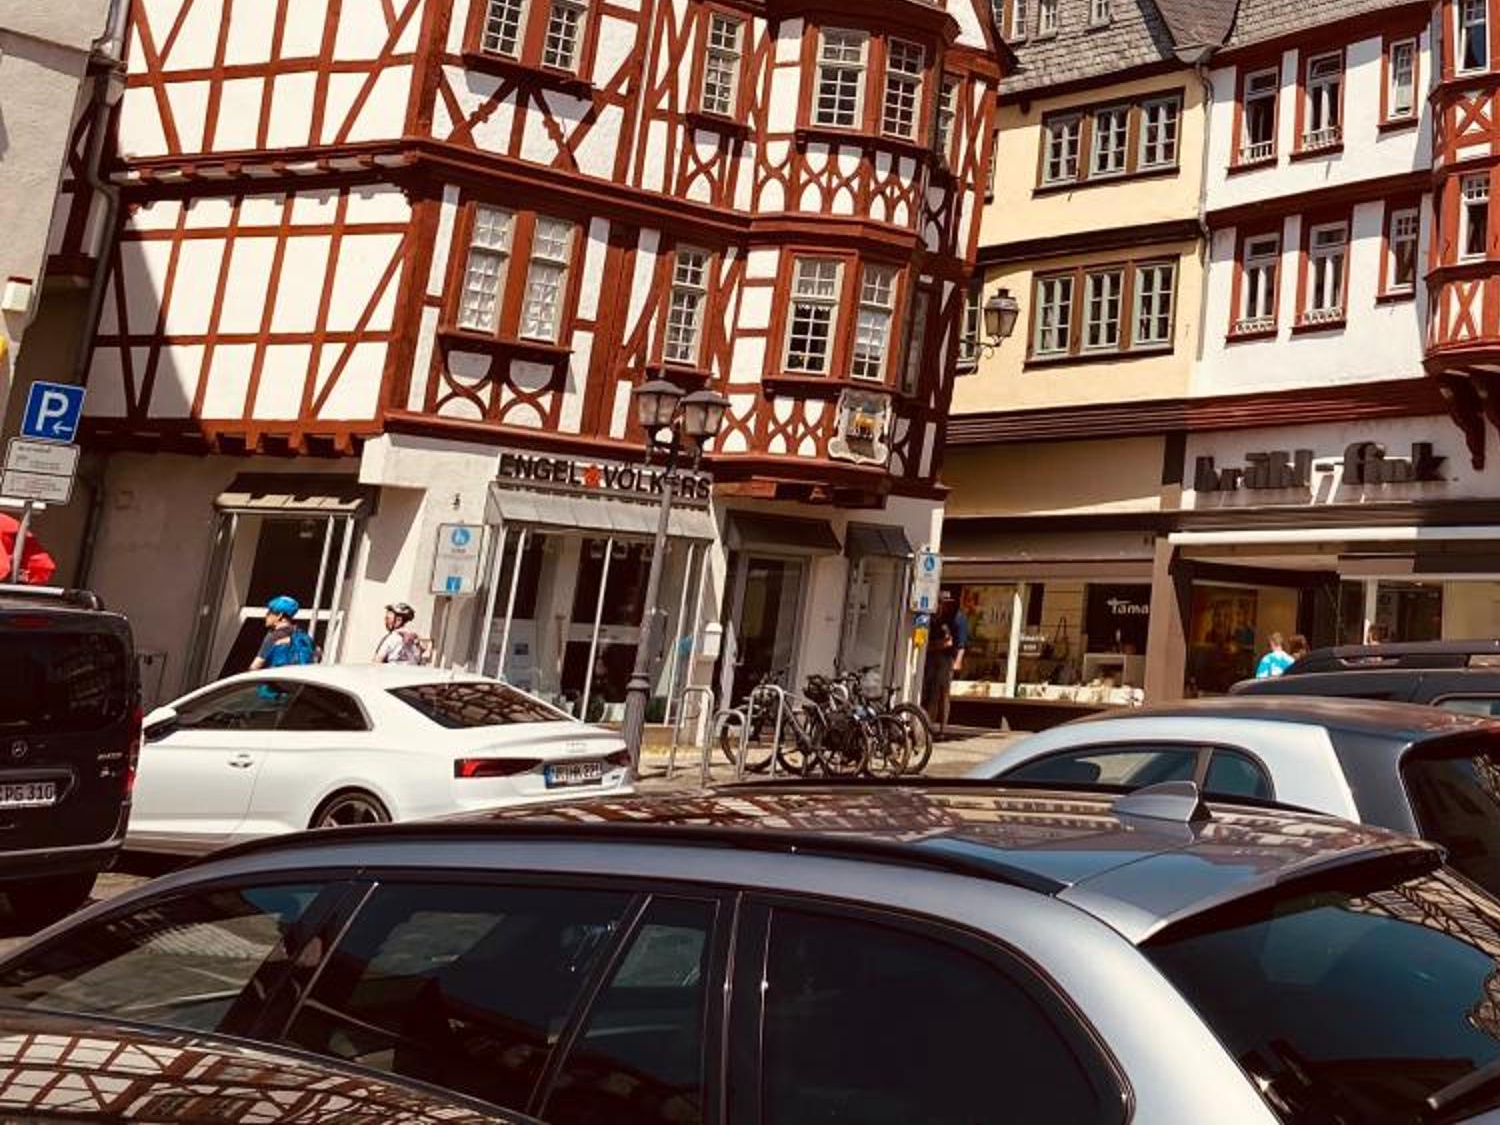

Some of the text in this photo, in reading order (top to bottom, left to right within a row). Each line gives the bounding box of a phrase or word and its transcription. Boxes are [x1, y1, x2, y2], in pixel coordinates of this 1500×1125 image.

[35, 390, 69, 431] P
[500, 453, 711, 499] ENGEL VÖLKERS
[27, 783, 53, 800] 310
